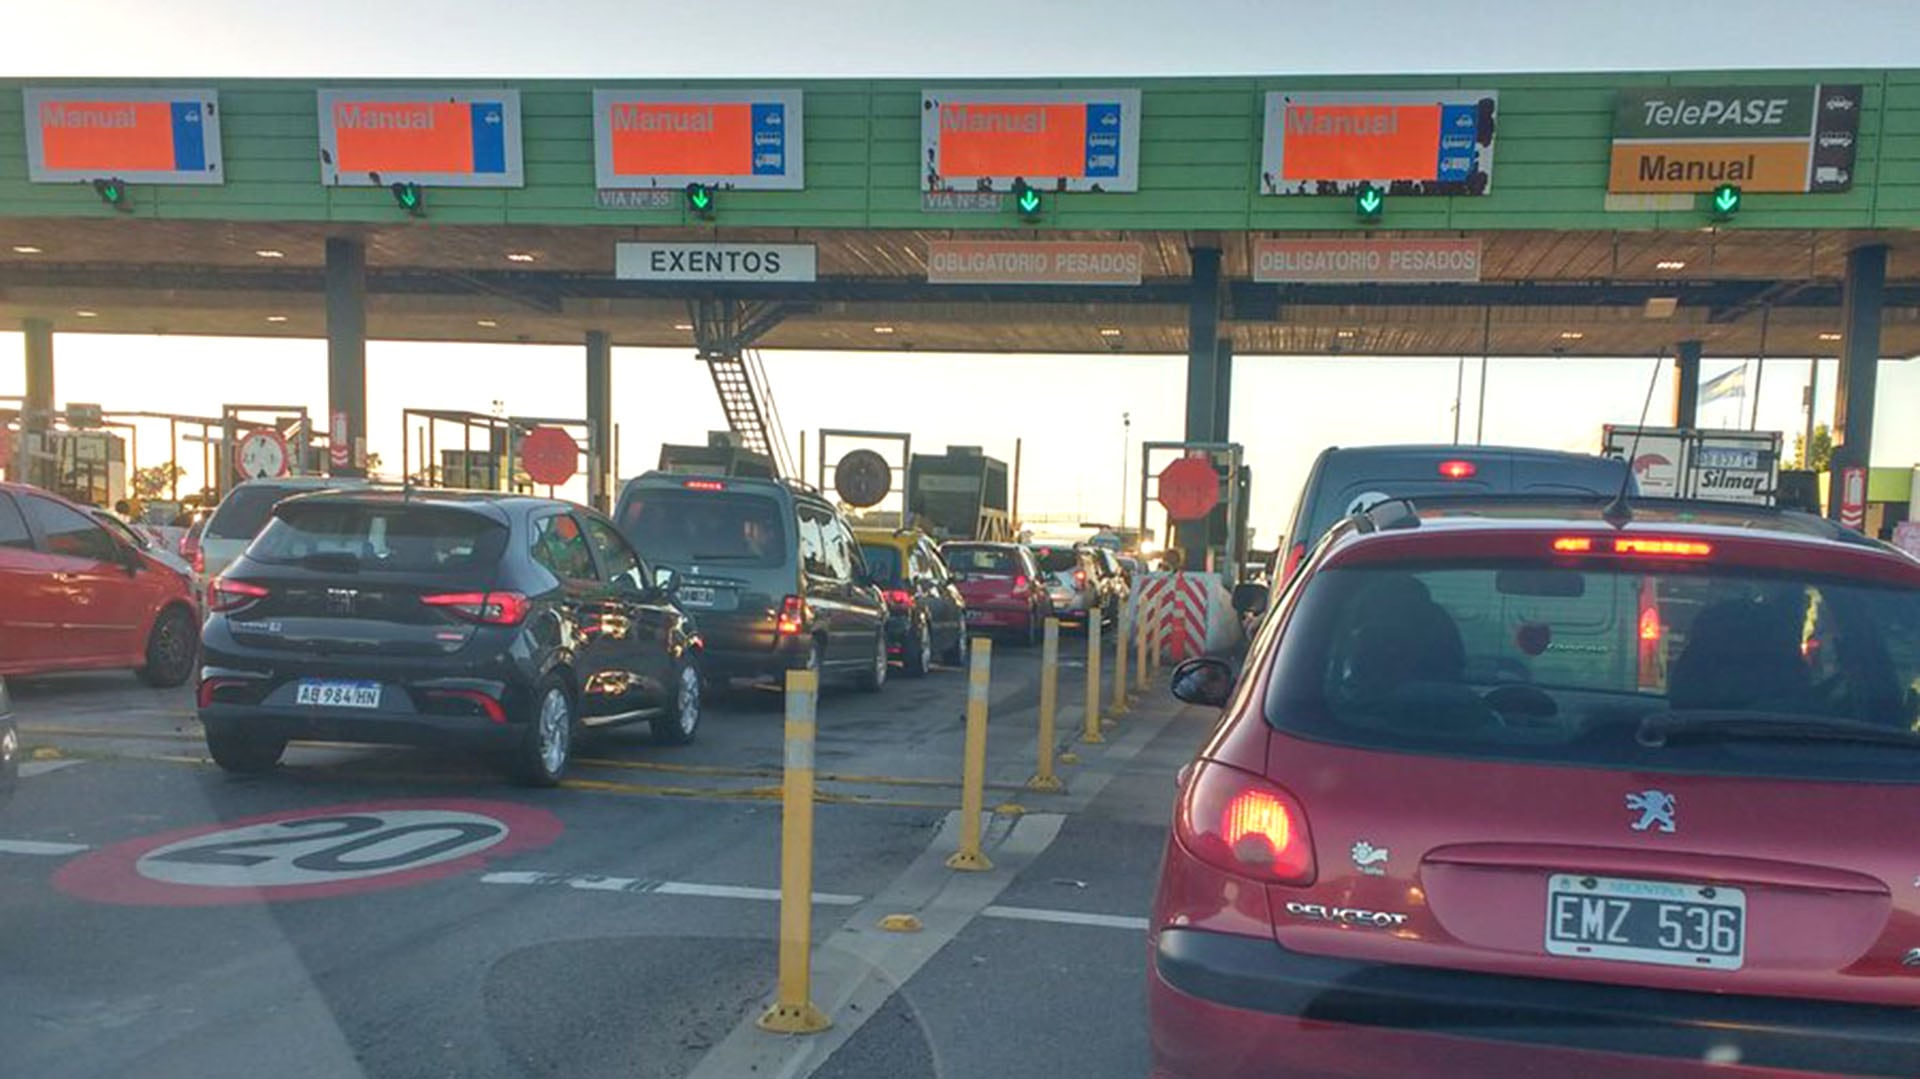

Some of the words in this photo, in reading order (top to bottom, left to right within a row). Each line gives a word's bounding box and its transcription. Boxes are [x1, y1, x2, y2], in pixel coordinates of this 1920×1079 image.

[40, 104, 137, 128] Manual
[335, 105, 435, 129] Manual
[613, 105, 714, 131] Manual
[942, 107, 1047, 132] Manual
[1287, 109, 1398, 135] Manual
[1643, 99, 1788, 126] TelePASE
[1638, 154, 1756, 181] Manual
[651, 251, 781, 273] EXENTOS
[933, 251, 1047, 273] OBLIGATORIO
[1055, 252, 1138, 274] PESADOS
[1260, 251, 1380, 271] OBLIGATORIO
[1389, 252, 1475, 270] PESADOS
[1701, 470, 1764, 491] Silmar
[300, 687, 321, 702] AB
[323, 688, 352, 704] 984
[147, 816, 502, 871] 20
[1286, 902, 1408, 927] PEUGEOT
[1555, 895, 1631, 943] EMZ
[1658, 904, 1736, 953] 536
